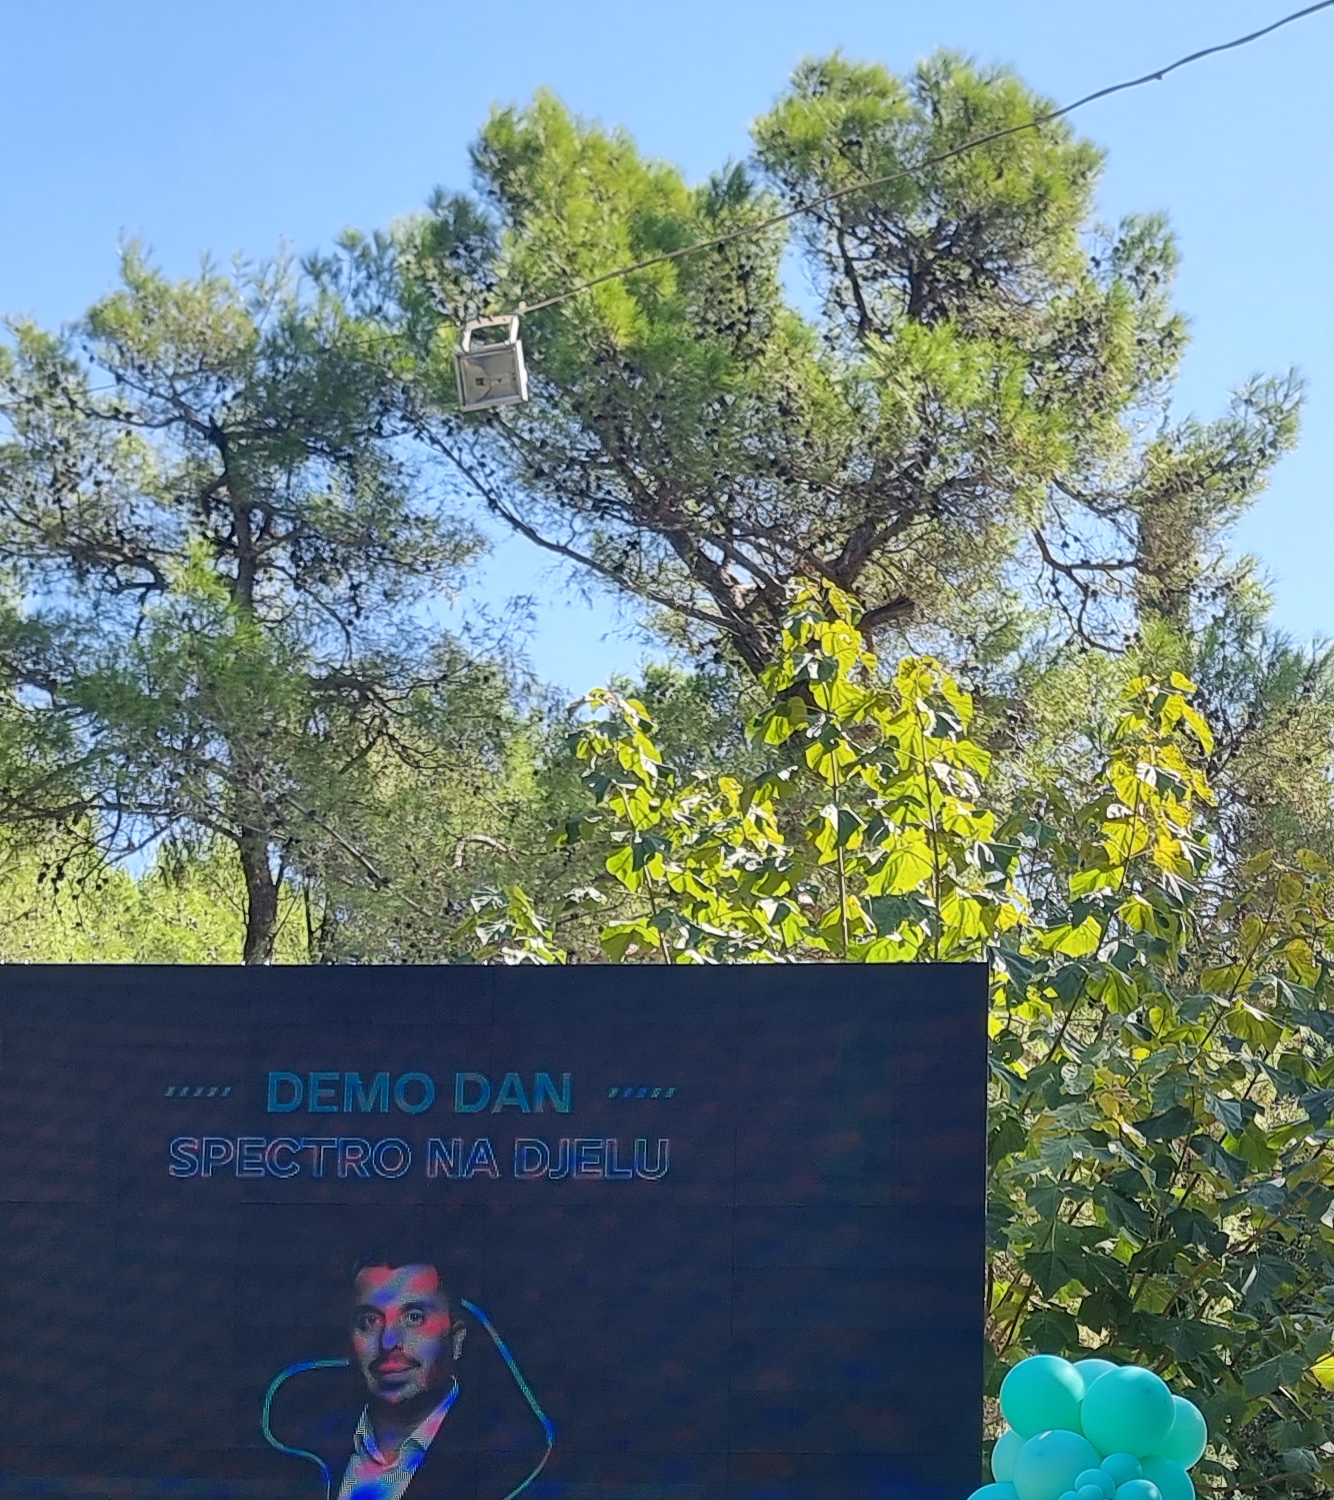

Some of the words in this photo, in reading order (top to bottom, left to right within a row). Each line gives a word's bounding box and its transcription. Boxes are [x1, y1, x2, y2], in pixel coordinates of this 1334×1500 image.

[267, 1071, 435, 1114] DEMO
[454, 1072, 573, 1114] DAN
[168, 1137, 413, 1178] SPECTRO
[426, 1138, 501, 1179] NA
[513, 1138, 670, 1180] DJELU
